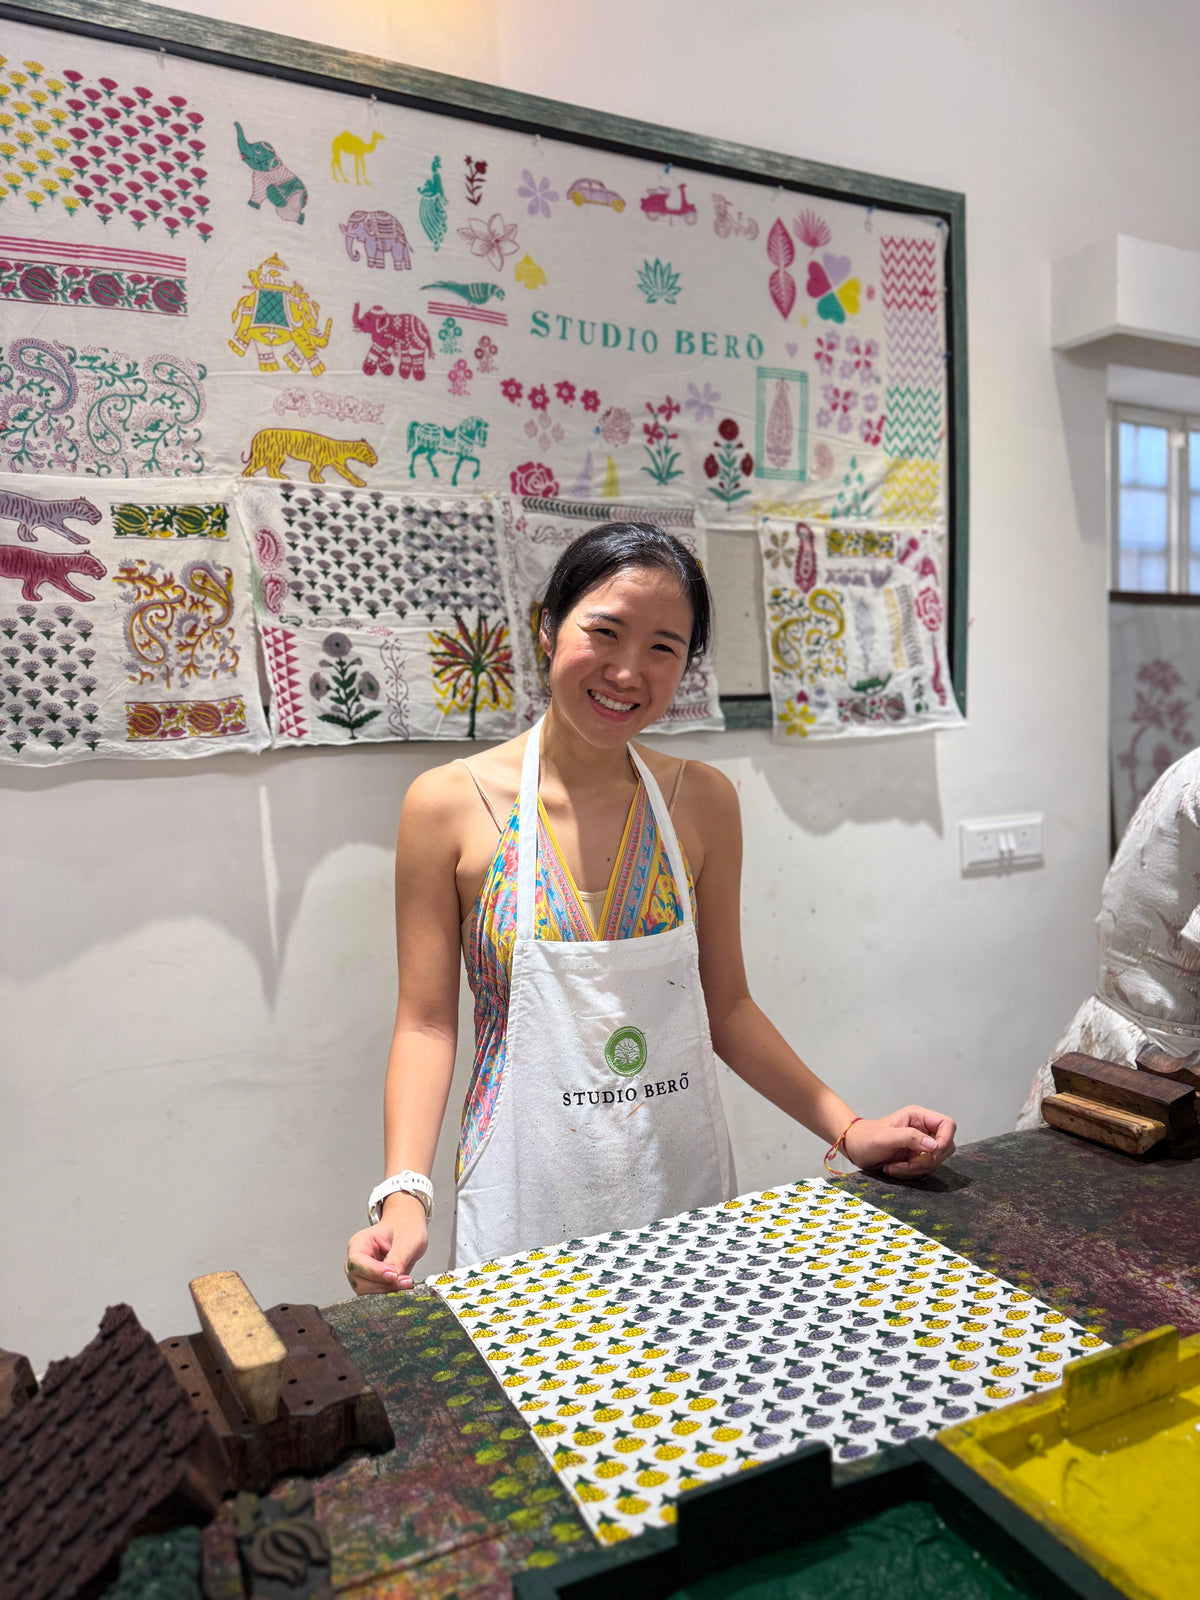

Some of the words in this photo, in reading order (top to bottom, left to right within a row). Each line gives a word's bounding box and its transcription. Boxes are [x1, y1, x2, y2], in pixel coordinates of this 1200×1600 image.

[530, 310, 658, 354] STUDIO
[562, 1087, 637, 1106] STUDIO
[644, 1071, 690, 1099] BERÕ
